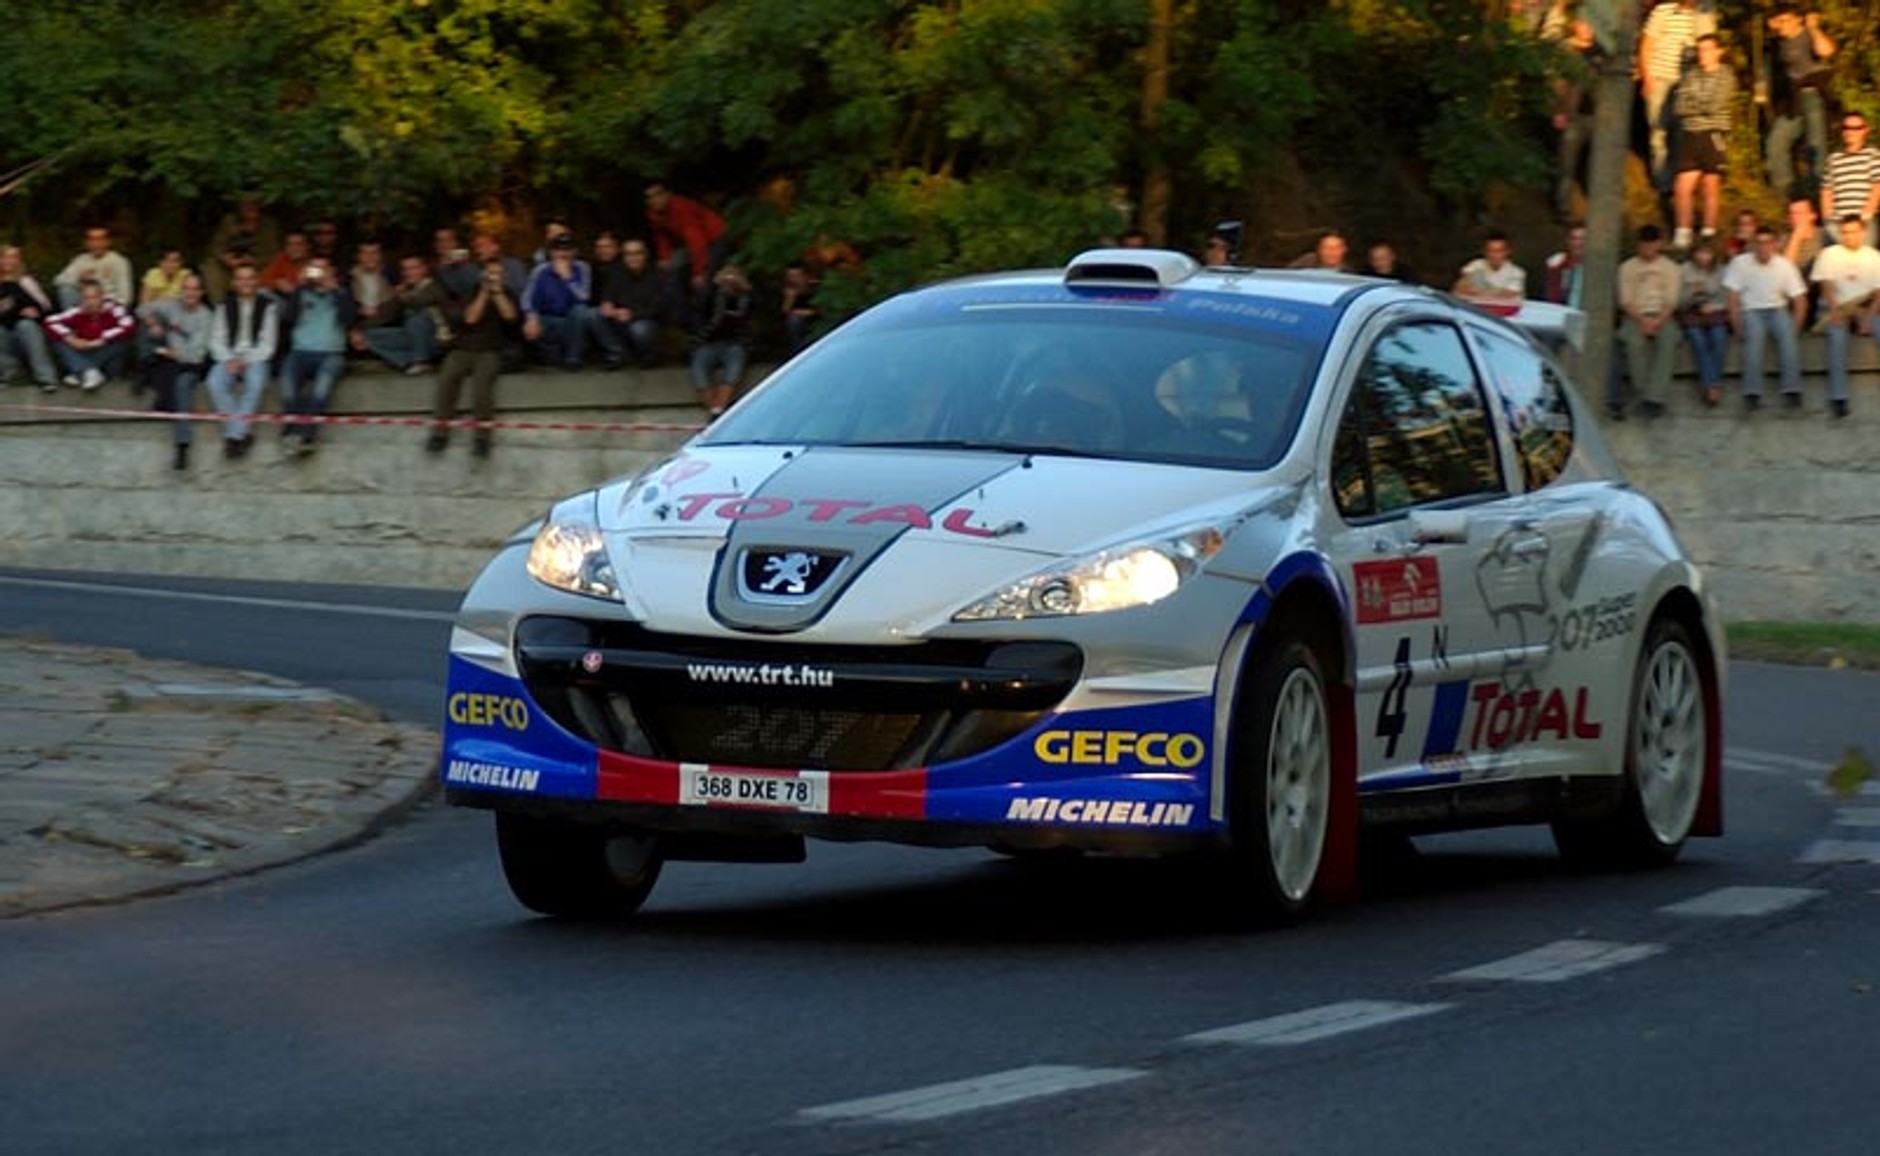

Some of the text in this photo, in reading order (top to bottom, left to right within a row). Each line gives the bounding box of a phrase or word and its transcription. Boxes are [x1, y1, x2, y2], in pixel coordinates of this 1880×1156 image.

[677, 492, 1000, 538] TOTAL
[1432, 625, 1450, 669] N
[688, 664, 834, 688] www.trt.hu
[448, 693, 529, 731] GEFCO
[1376, 637, 1413, 758] 4
[1472, 683, 1602, 750] TOTAL
[1034, 731, 1205, 768] GEFCO
[447, 760, 540, 791] MICHELIN
[698, 776, 808, 802] 368 DXE 78
[1007, 798, 1194, 826] MICHELIN
